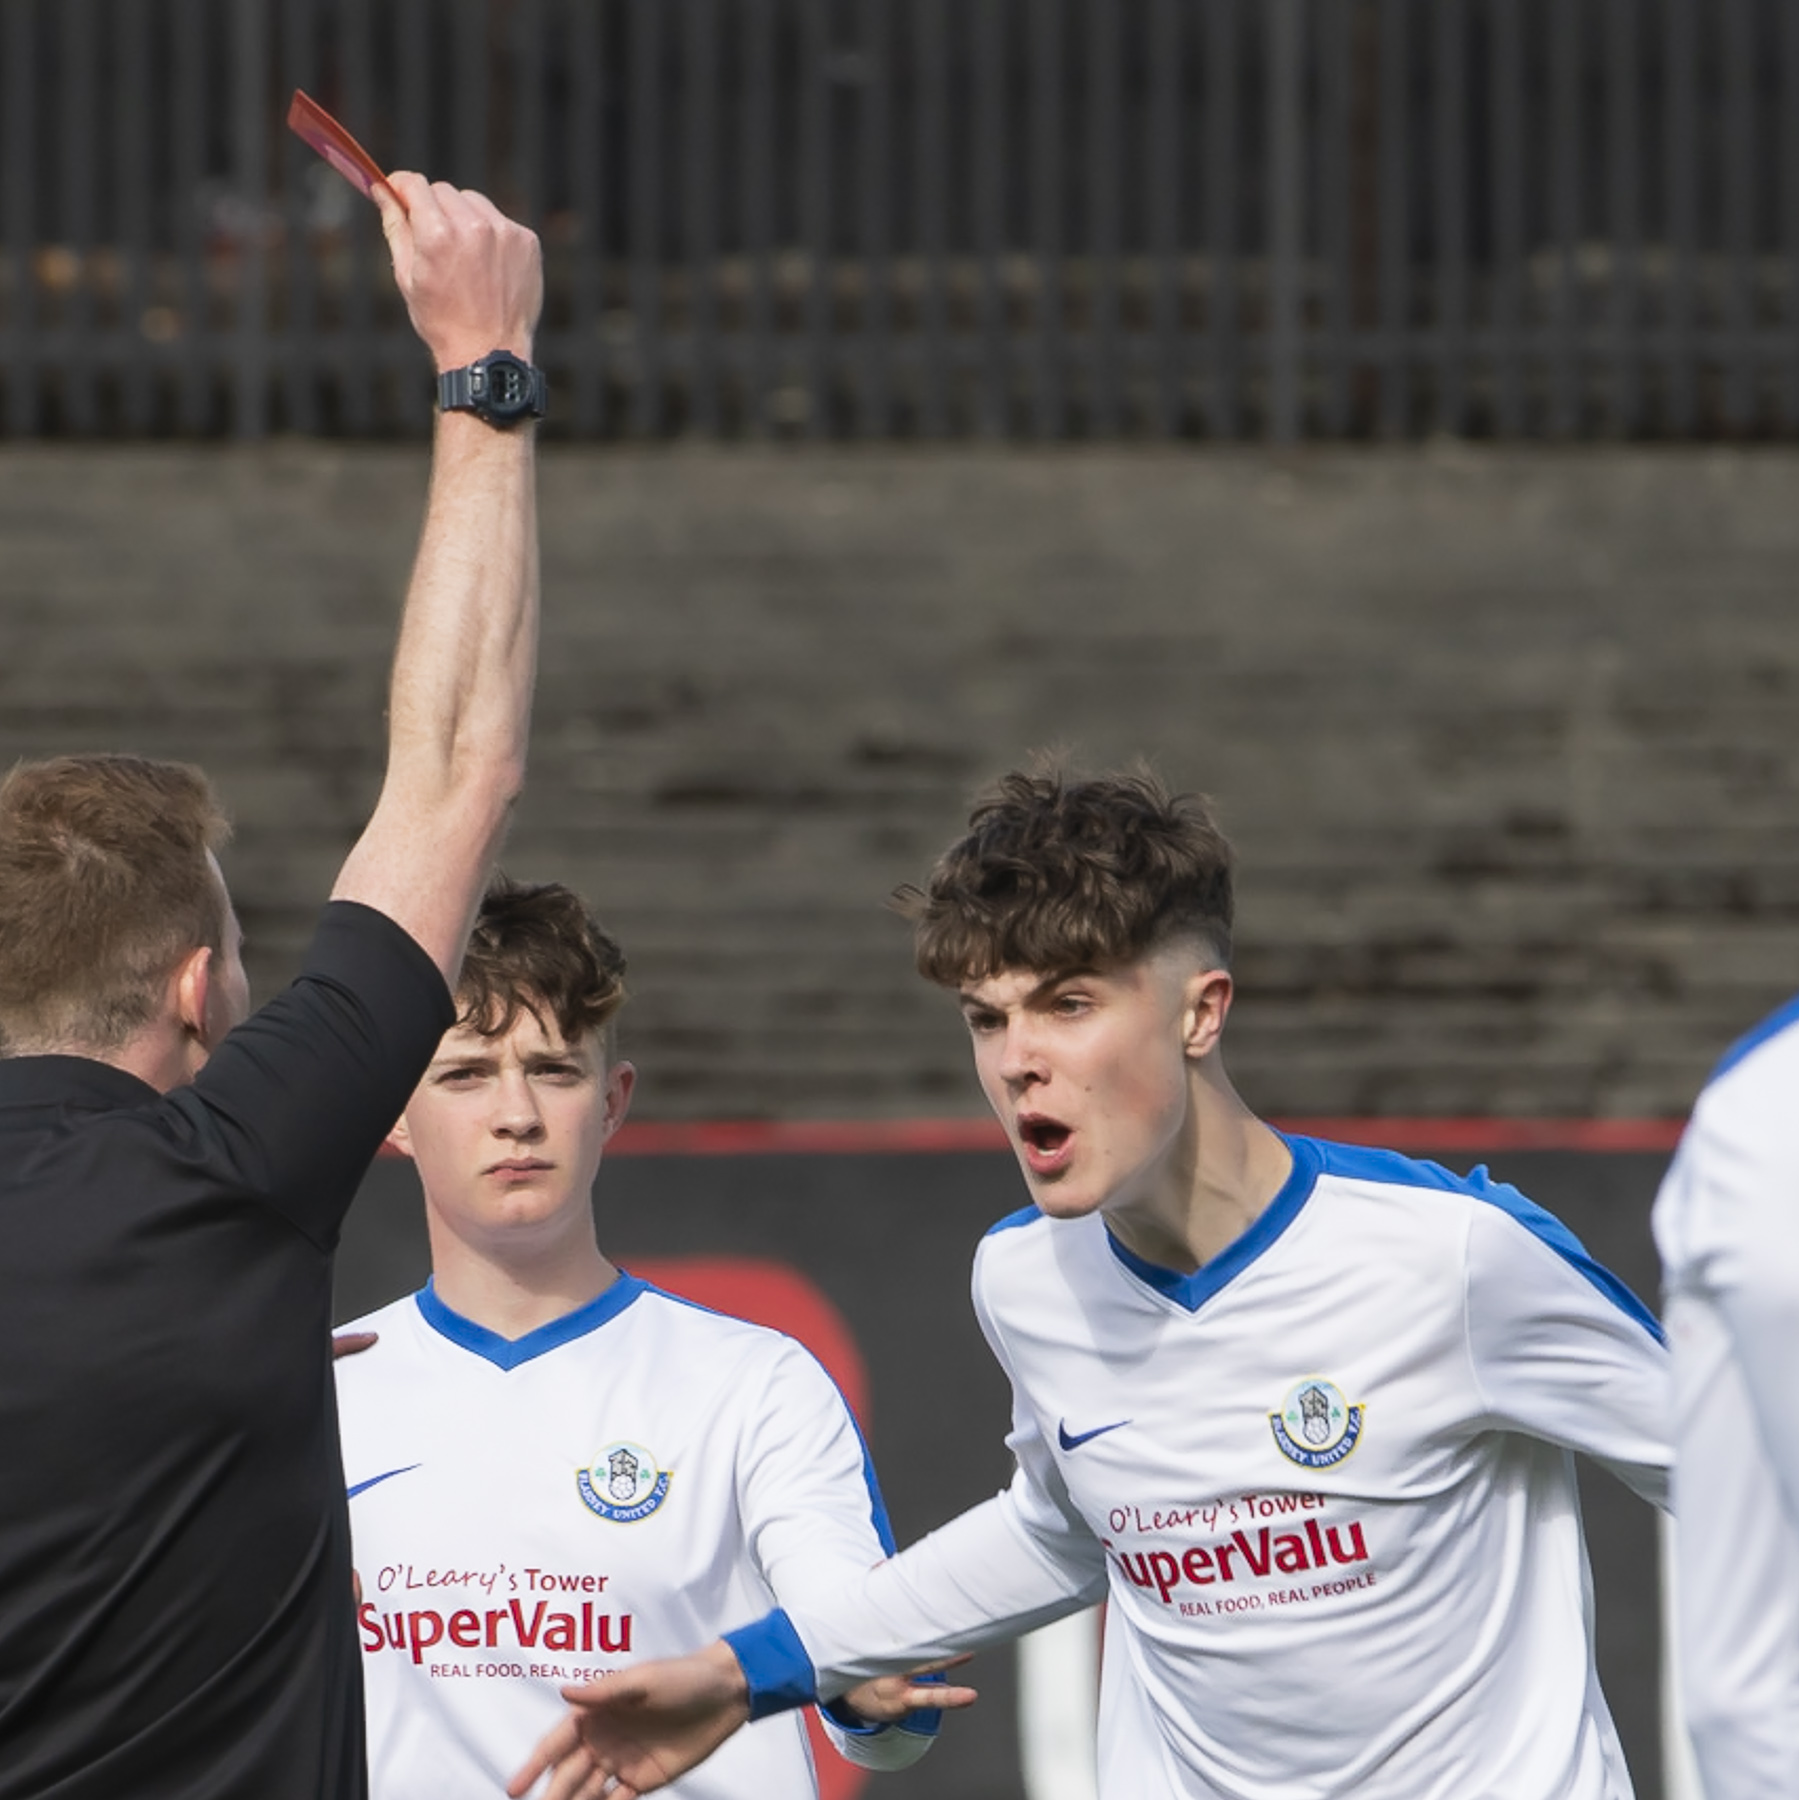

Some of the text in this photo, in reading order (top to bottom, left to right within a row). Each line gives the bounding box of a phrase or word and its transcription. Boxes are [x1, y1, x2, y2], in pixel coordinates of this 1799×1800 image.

[612, 1498, 657, 1519] UNITED
[1109, 1492, 1326, 1533] O'Leary's Tower
[377, 1563, 609, 1595] O'Leary's Tower
[1102, 1518, 1369, 1604] uperValu
[1180, 1602, 1213, 1617] REAL
[1268, 1588, 1307, 1606] REAL
[1312, 1572, 1376, 1599] PEOPLE
[357, 1598, 632, 1665] SuperValu
[430, 1663, 471, 1678] REAL
[530, 1664, 569, 1680] REAL
